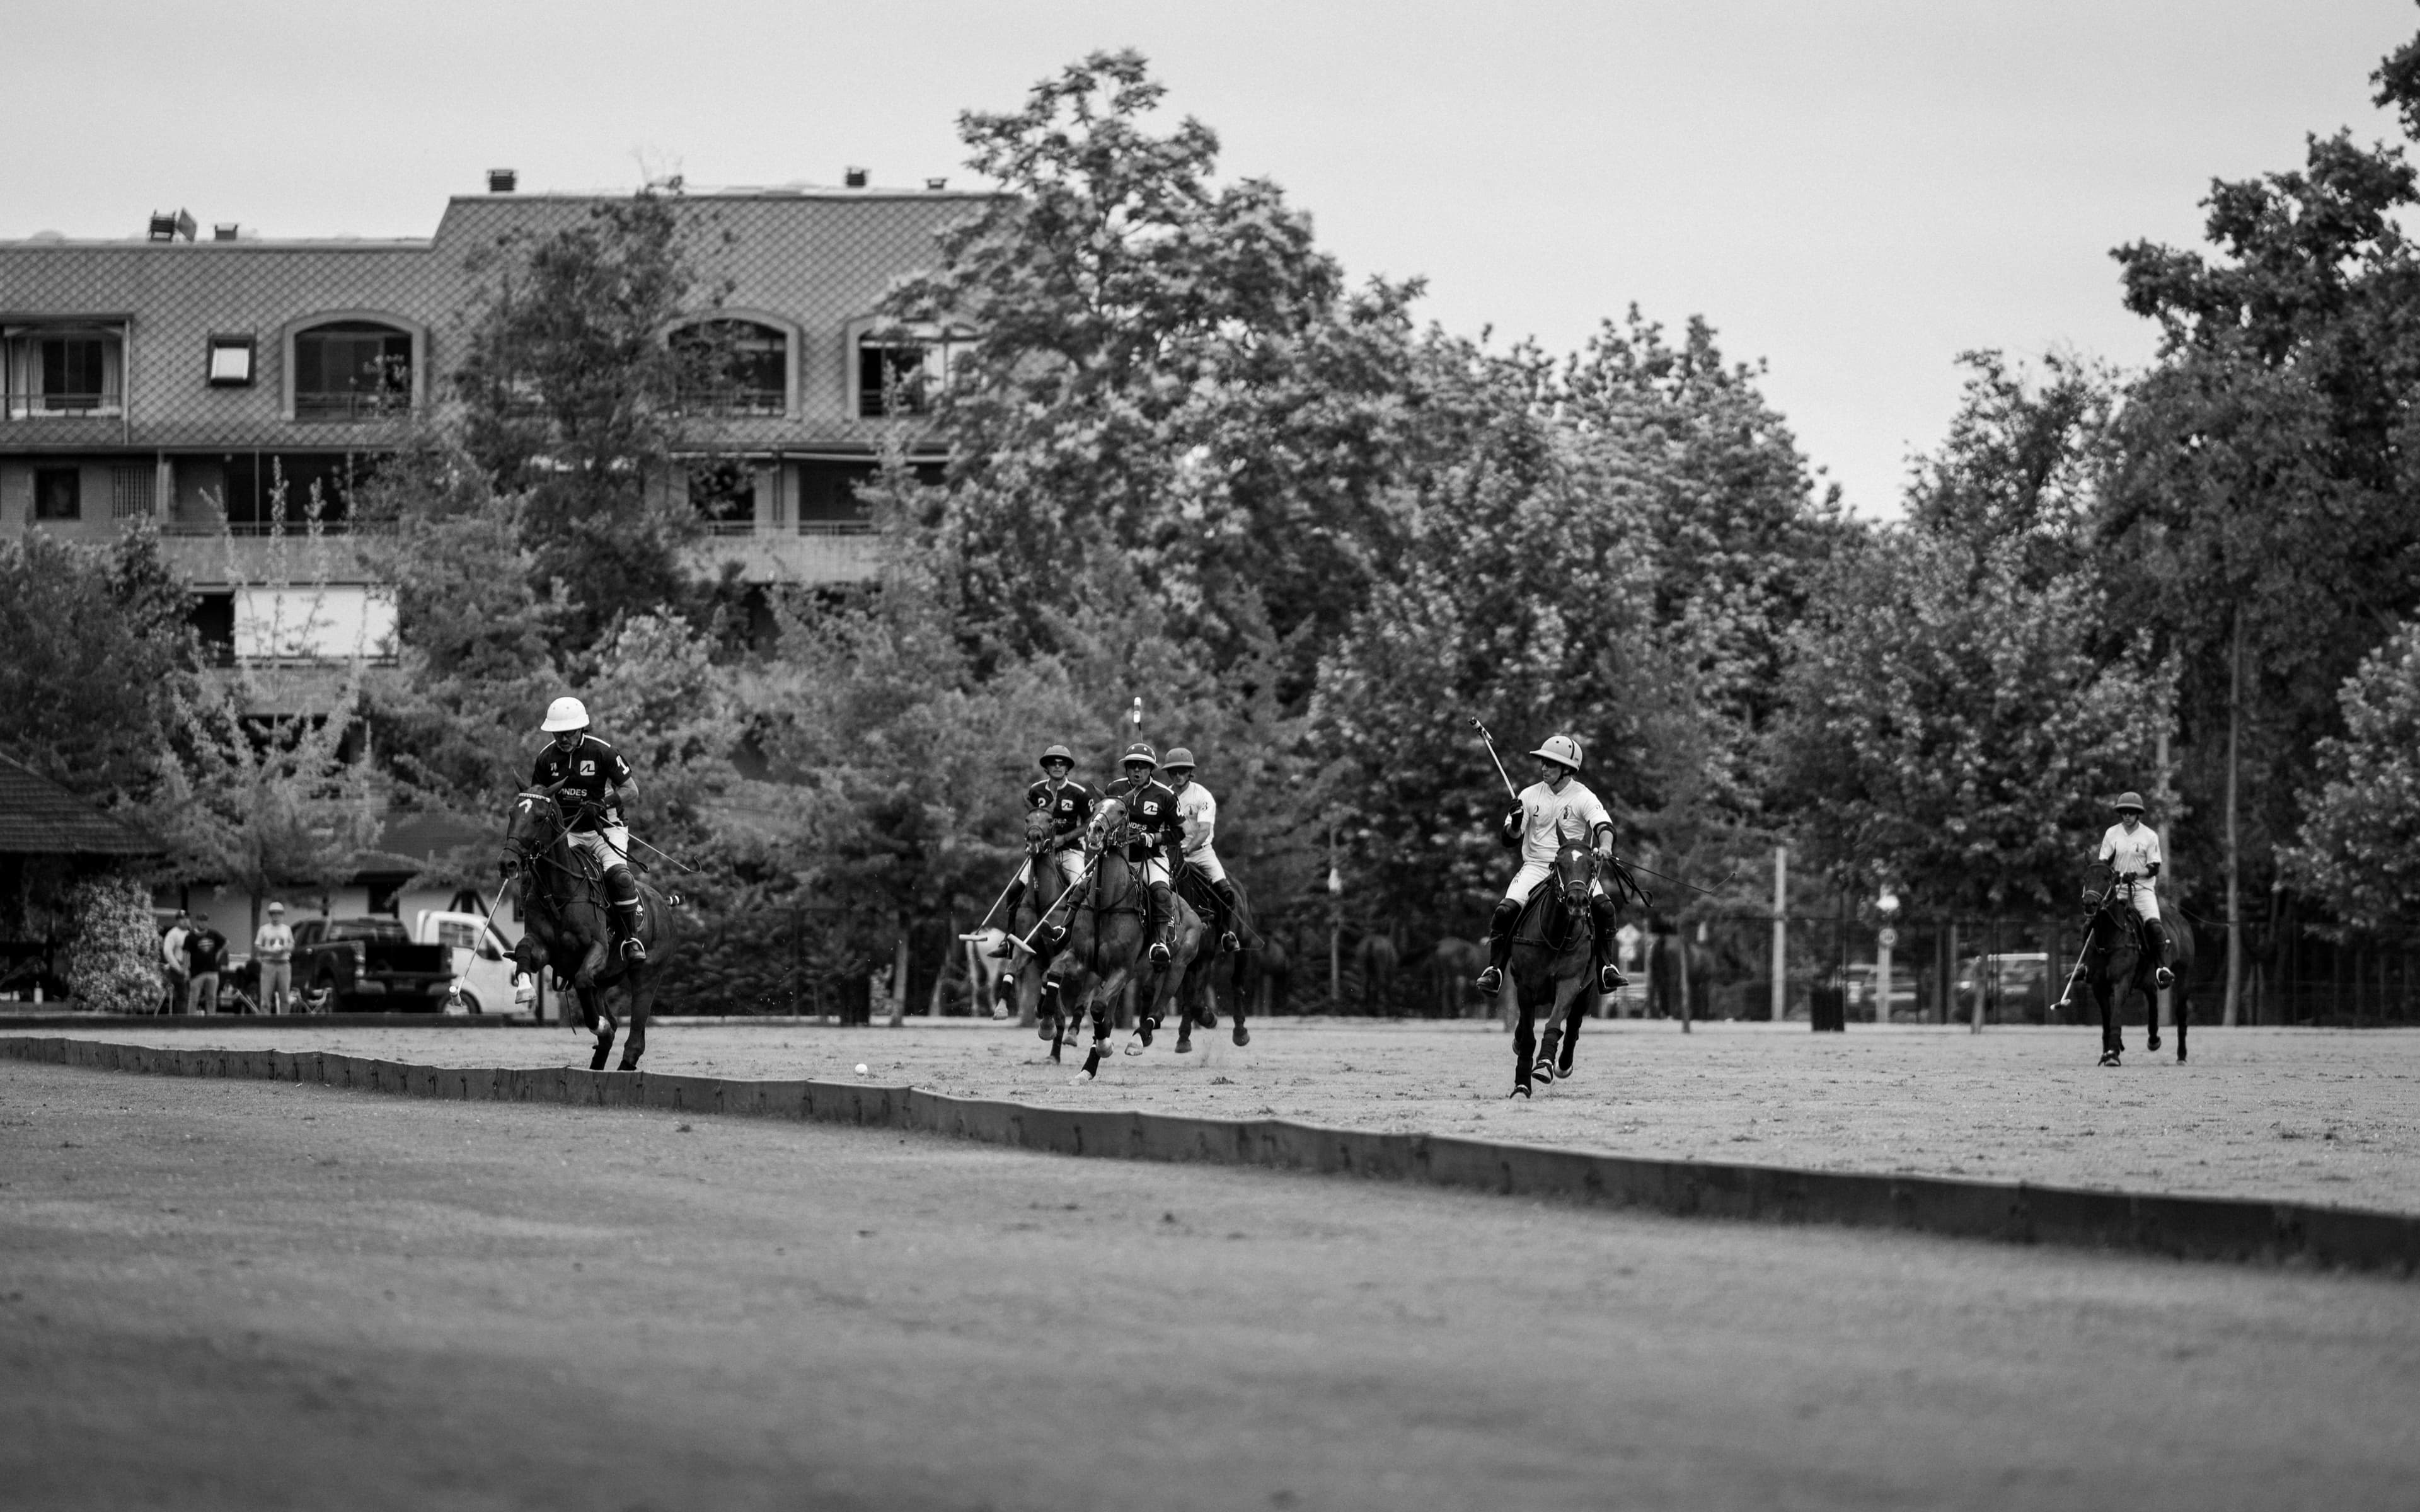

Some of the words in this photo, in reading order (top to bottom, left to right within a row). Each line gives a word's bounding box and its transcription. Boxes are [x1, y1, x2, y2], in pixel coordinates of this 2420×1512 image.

[616, 755, 630, 775] 1
[558, 788, 587, 797] ANDES
[1202, 801, 1208, 811] 3
[1533, 805, 1539, 817] 2
[1129, 822, 1147, 830] NDES
